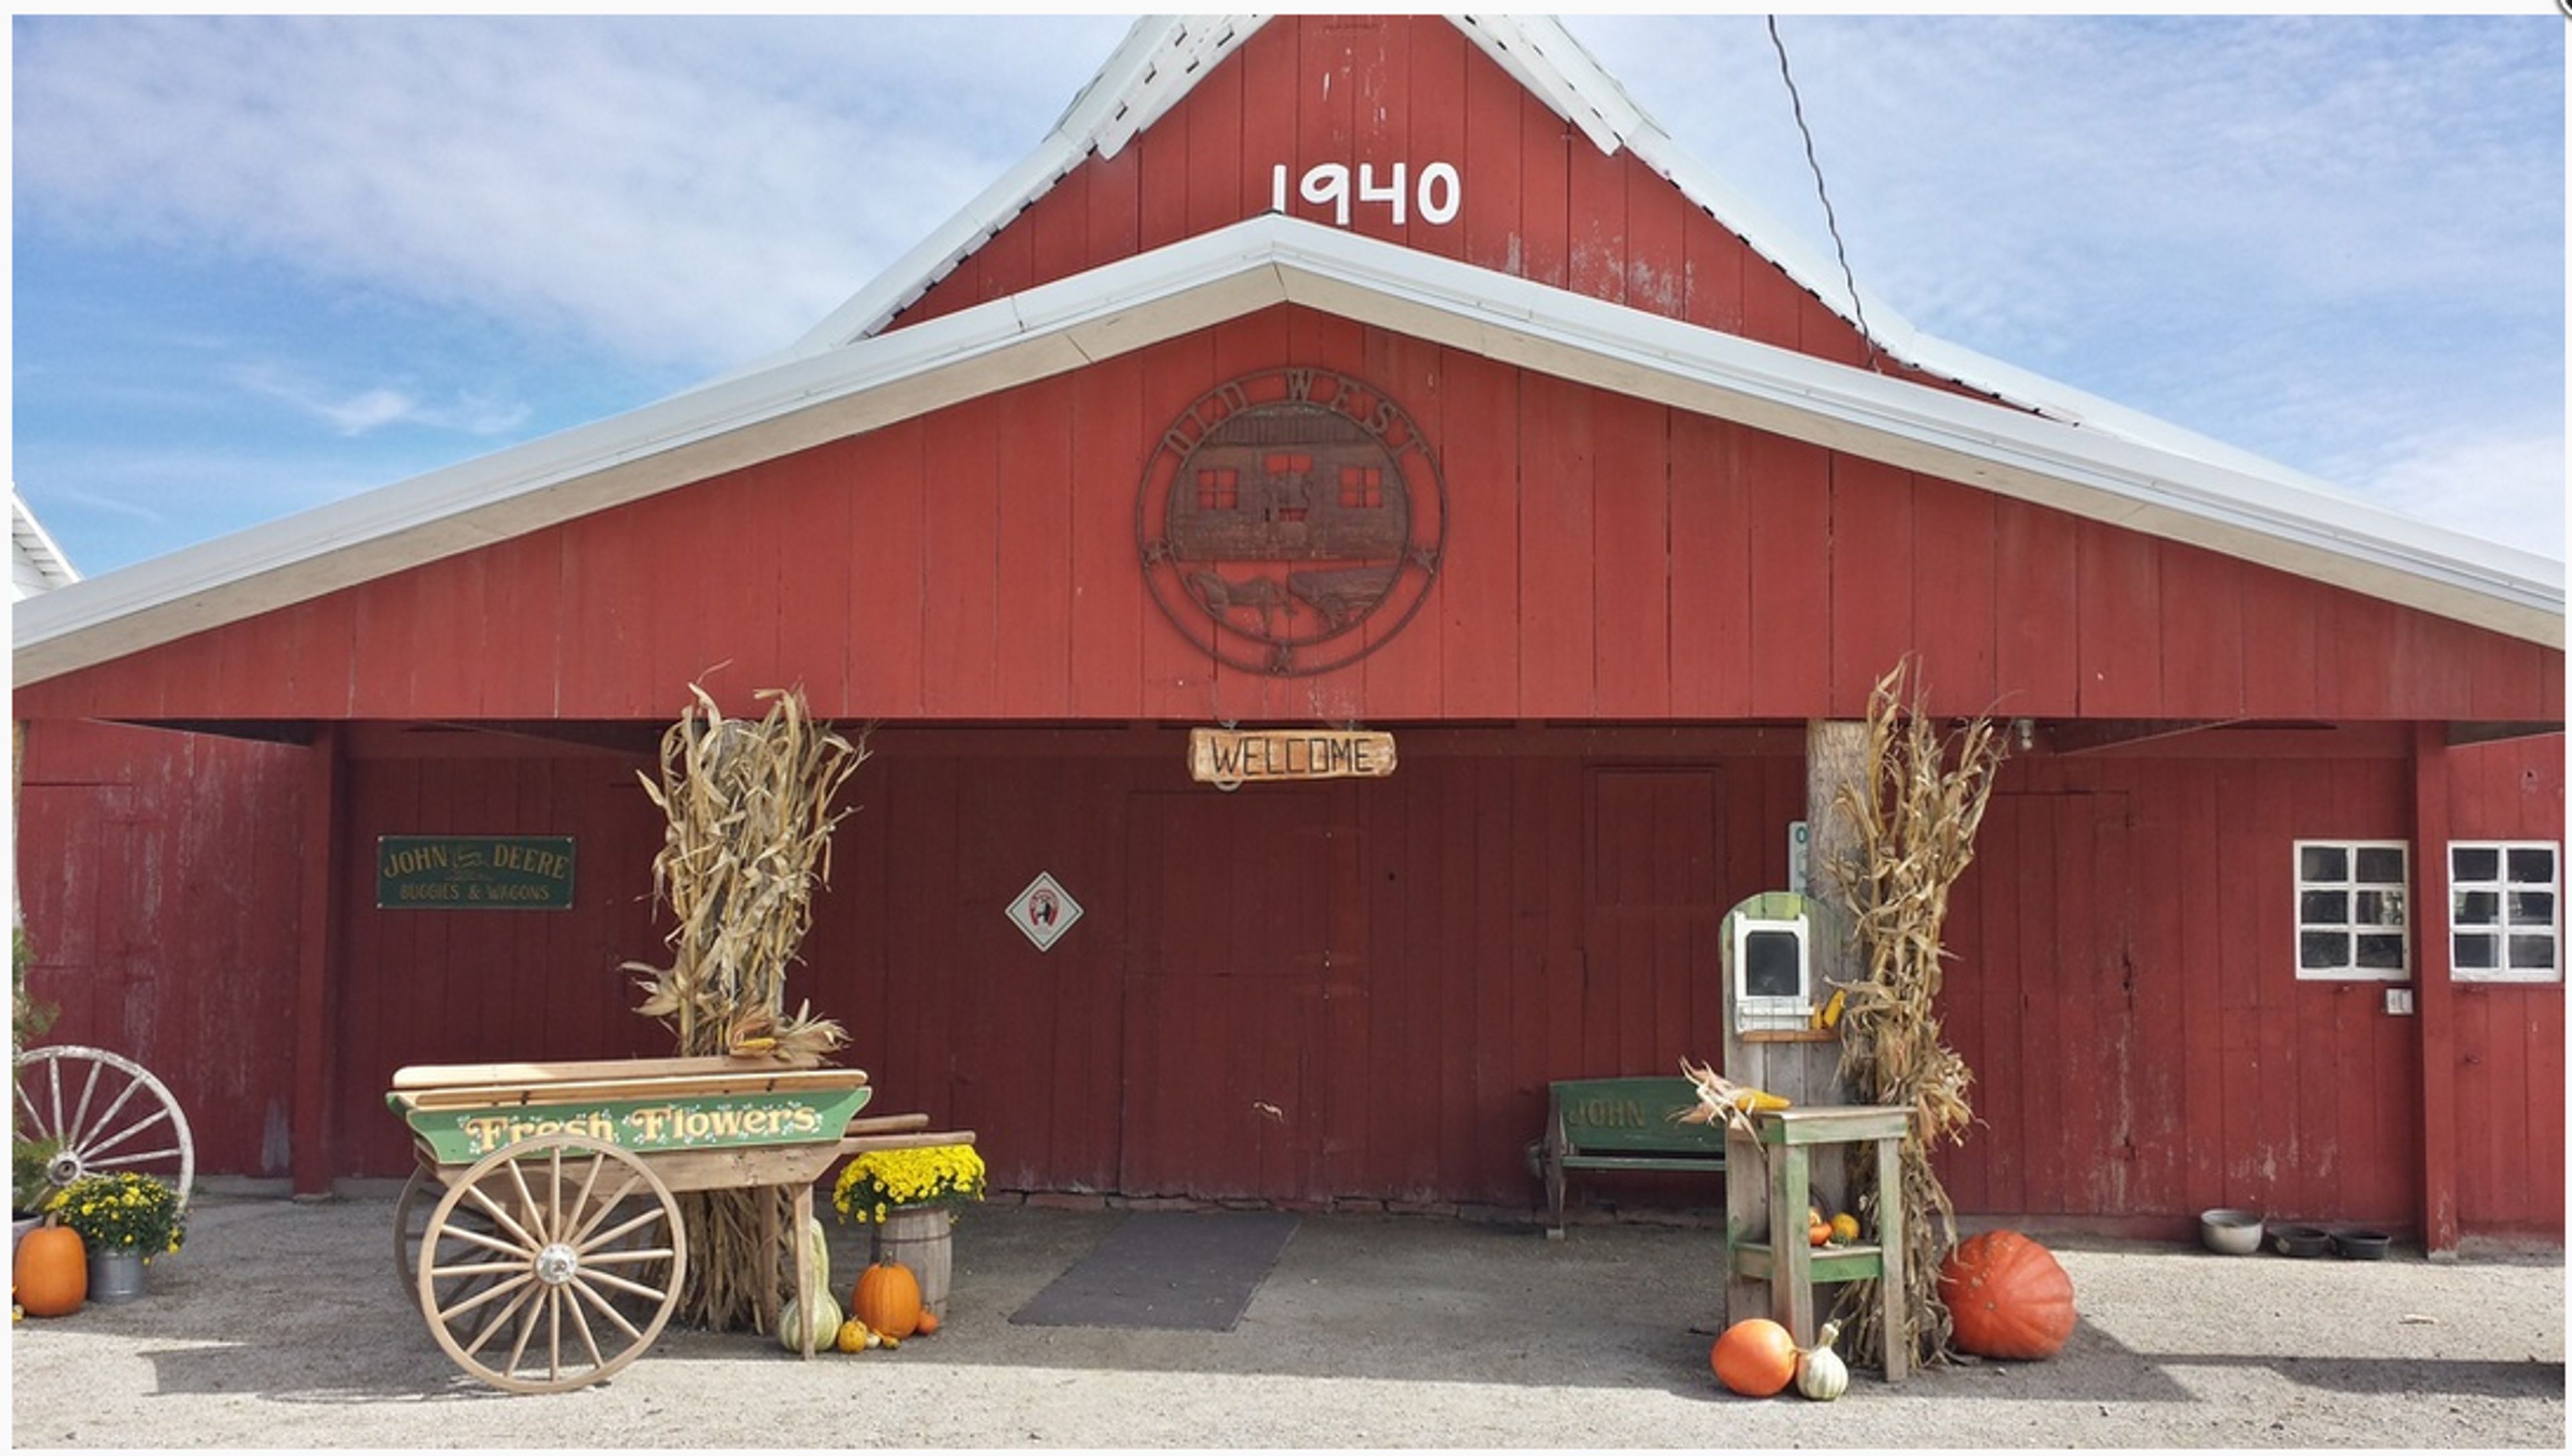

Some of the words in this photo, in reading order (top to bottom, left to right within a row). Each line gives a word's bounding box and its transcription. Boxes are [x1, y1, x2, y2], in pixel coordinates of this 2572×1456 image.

[1273, 163, 1460, 224] 1940
[1165, 381, 1248, 457] OLD
[1284, 368, 1428, 456] WEST
[1211, 736, 1374, 775] WELCOME
[384, 845, 447, 878] JOHN
[493, 844, 569, 880] DEERE
[399, 883, 460, 901] BUGGIES
[468, 884, 481, 901] &
[486, 884, 550, 901] WAGONS
[630, 1106, 816, 1140] Flowers
[1568, 1099, 1646, 1128] JOHN
